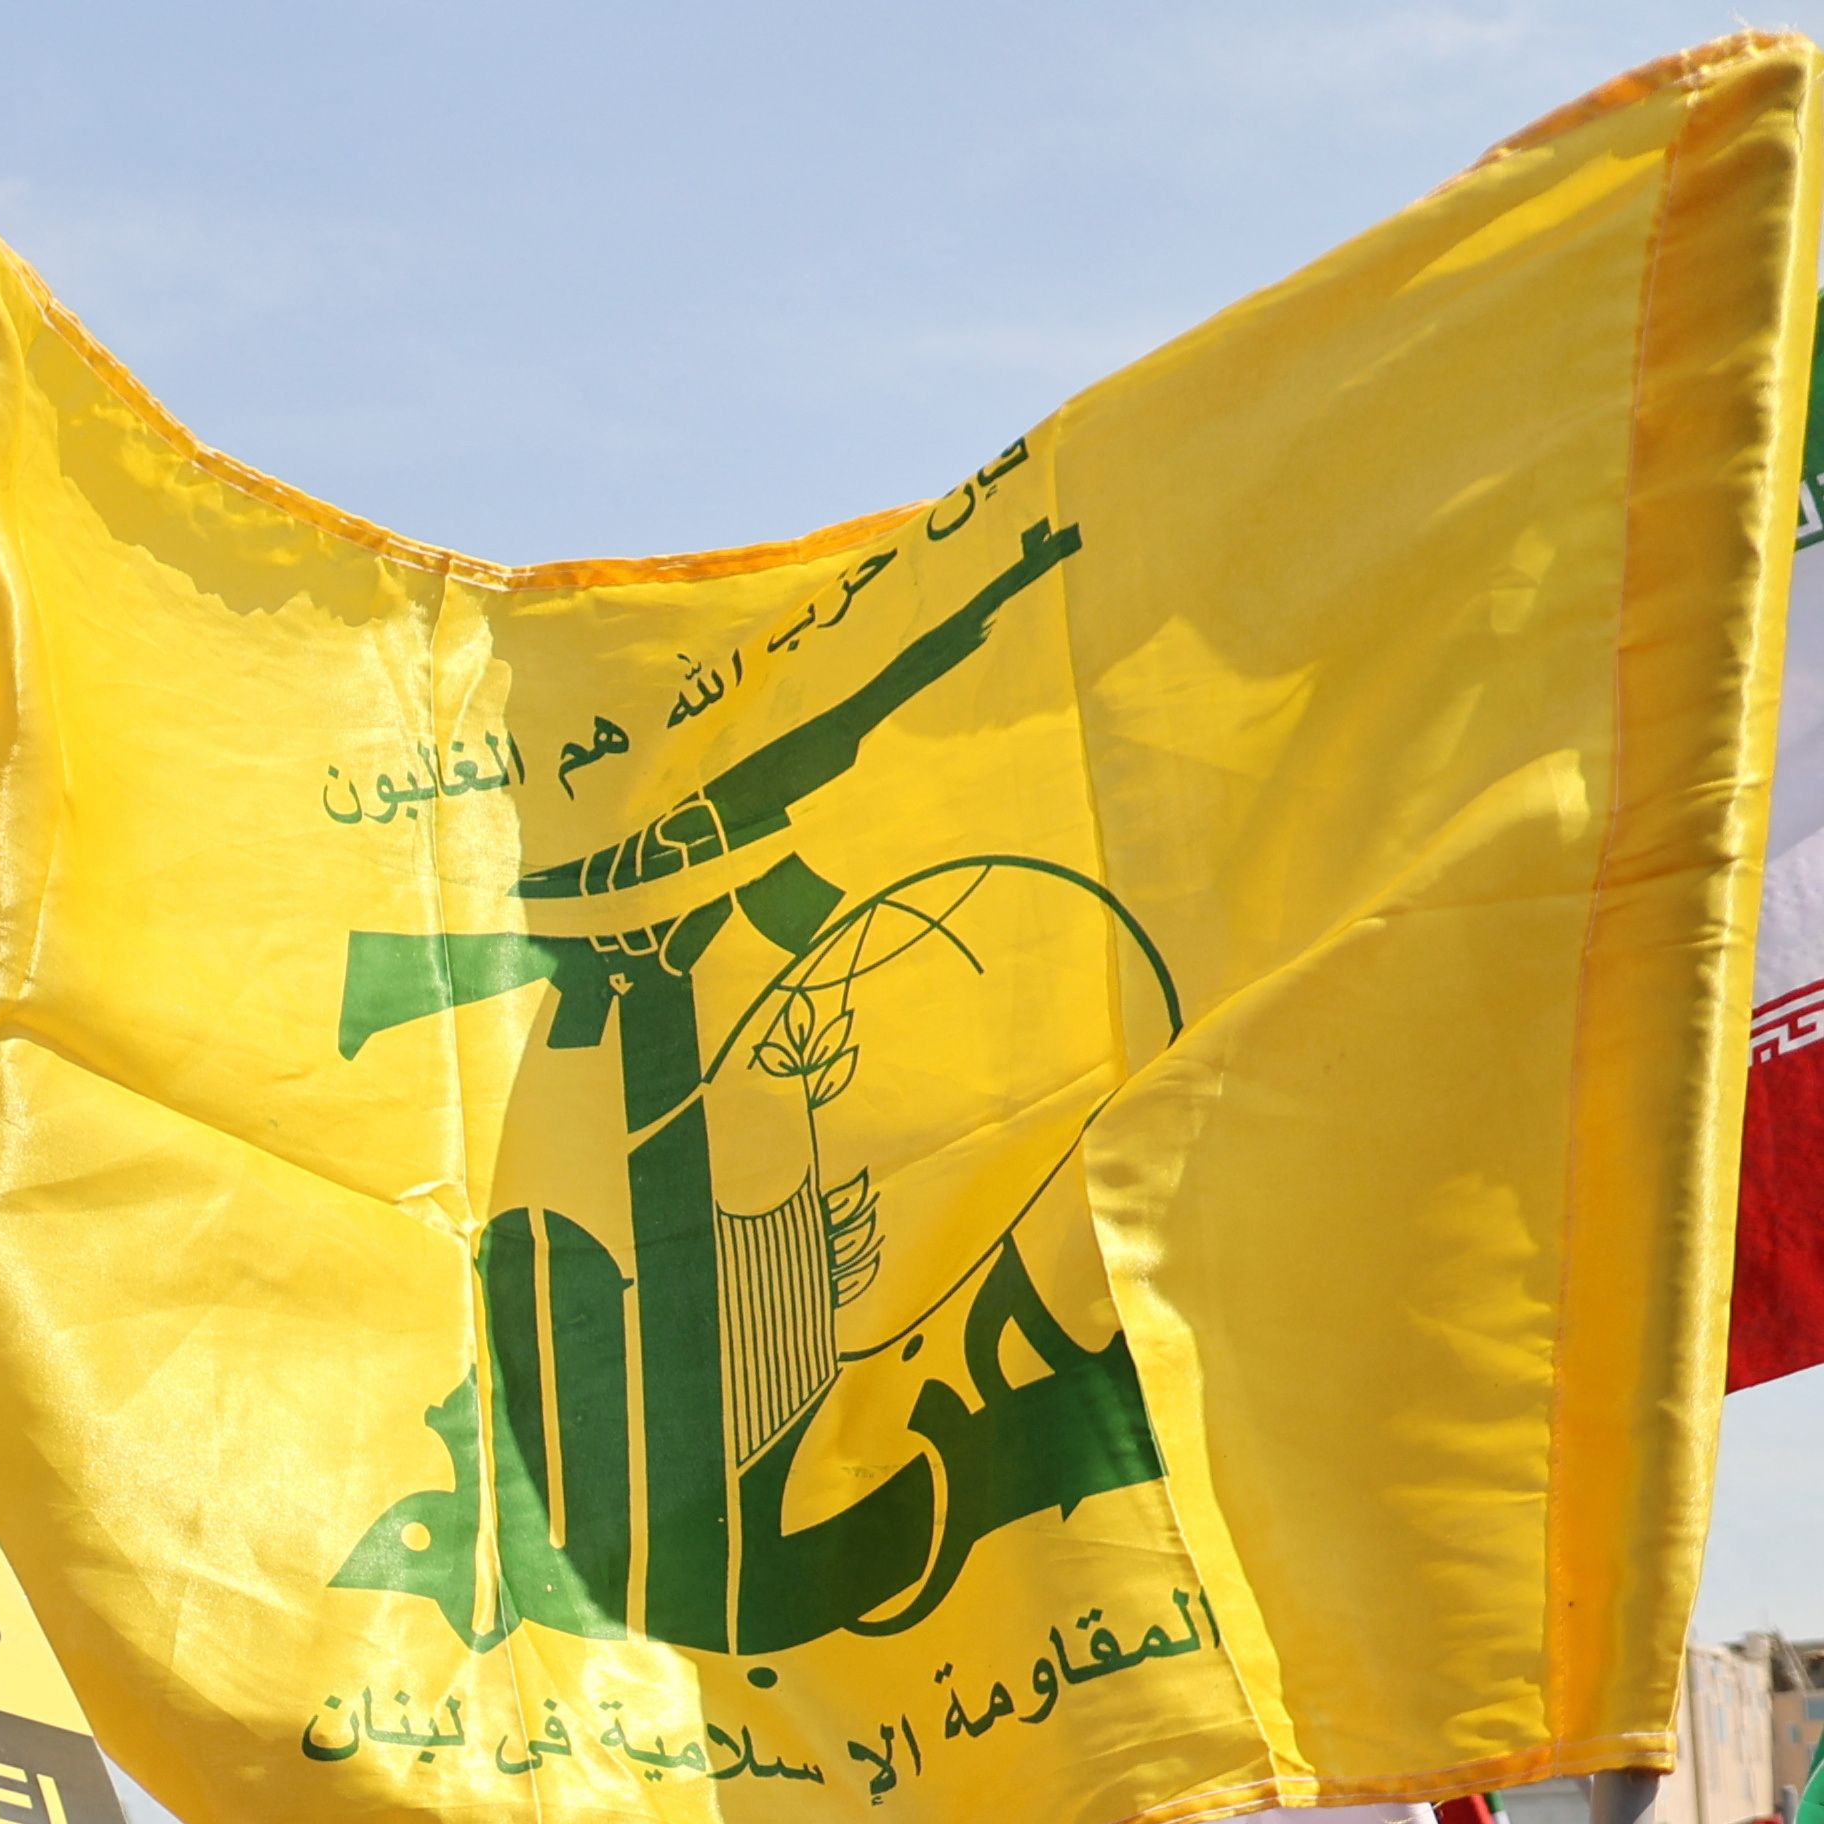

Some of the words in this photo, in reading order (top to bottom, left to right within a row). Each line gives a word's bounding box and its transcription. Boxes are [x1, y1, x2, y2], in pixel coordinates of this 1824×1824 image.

[767, 547, 898, 653] حزب
[667, 648, 744, 729] الله
[322, 730, 526, 825] الغالبون
[557, 715, 631, 800] هم
[934, 1585, 1223, 1745] المقاومة
[300, 1685, 469, 1766] لبنان
